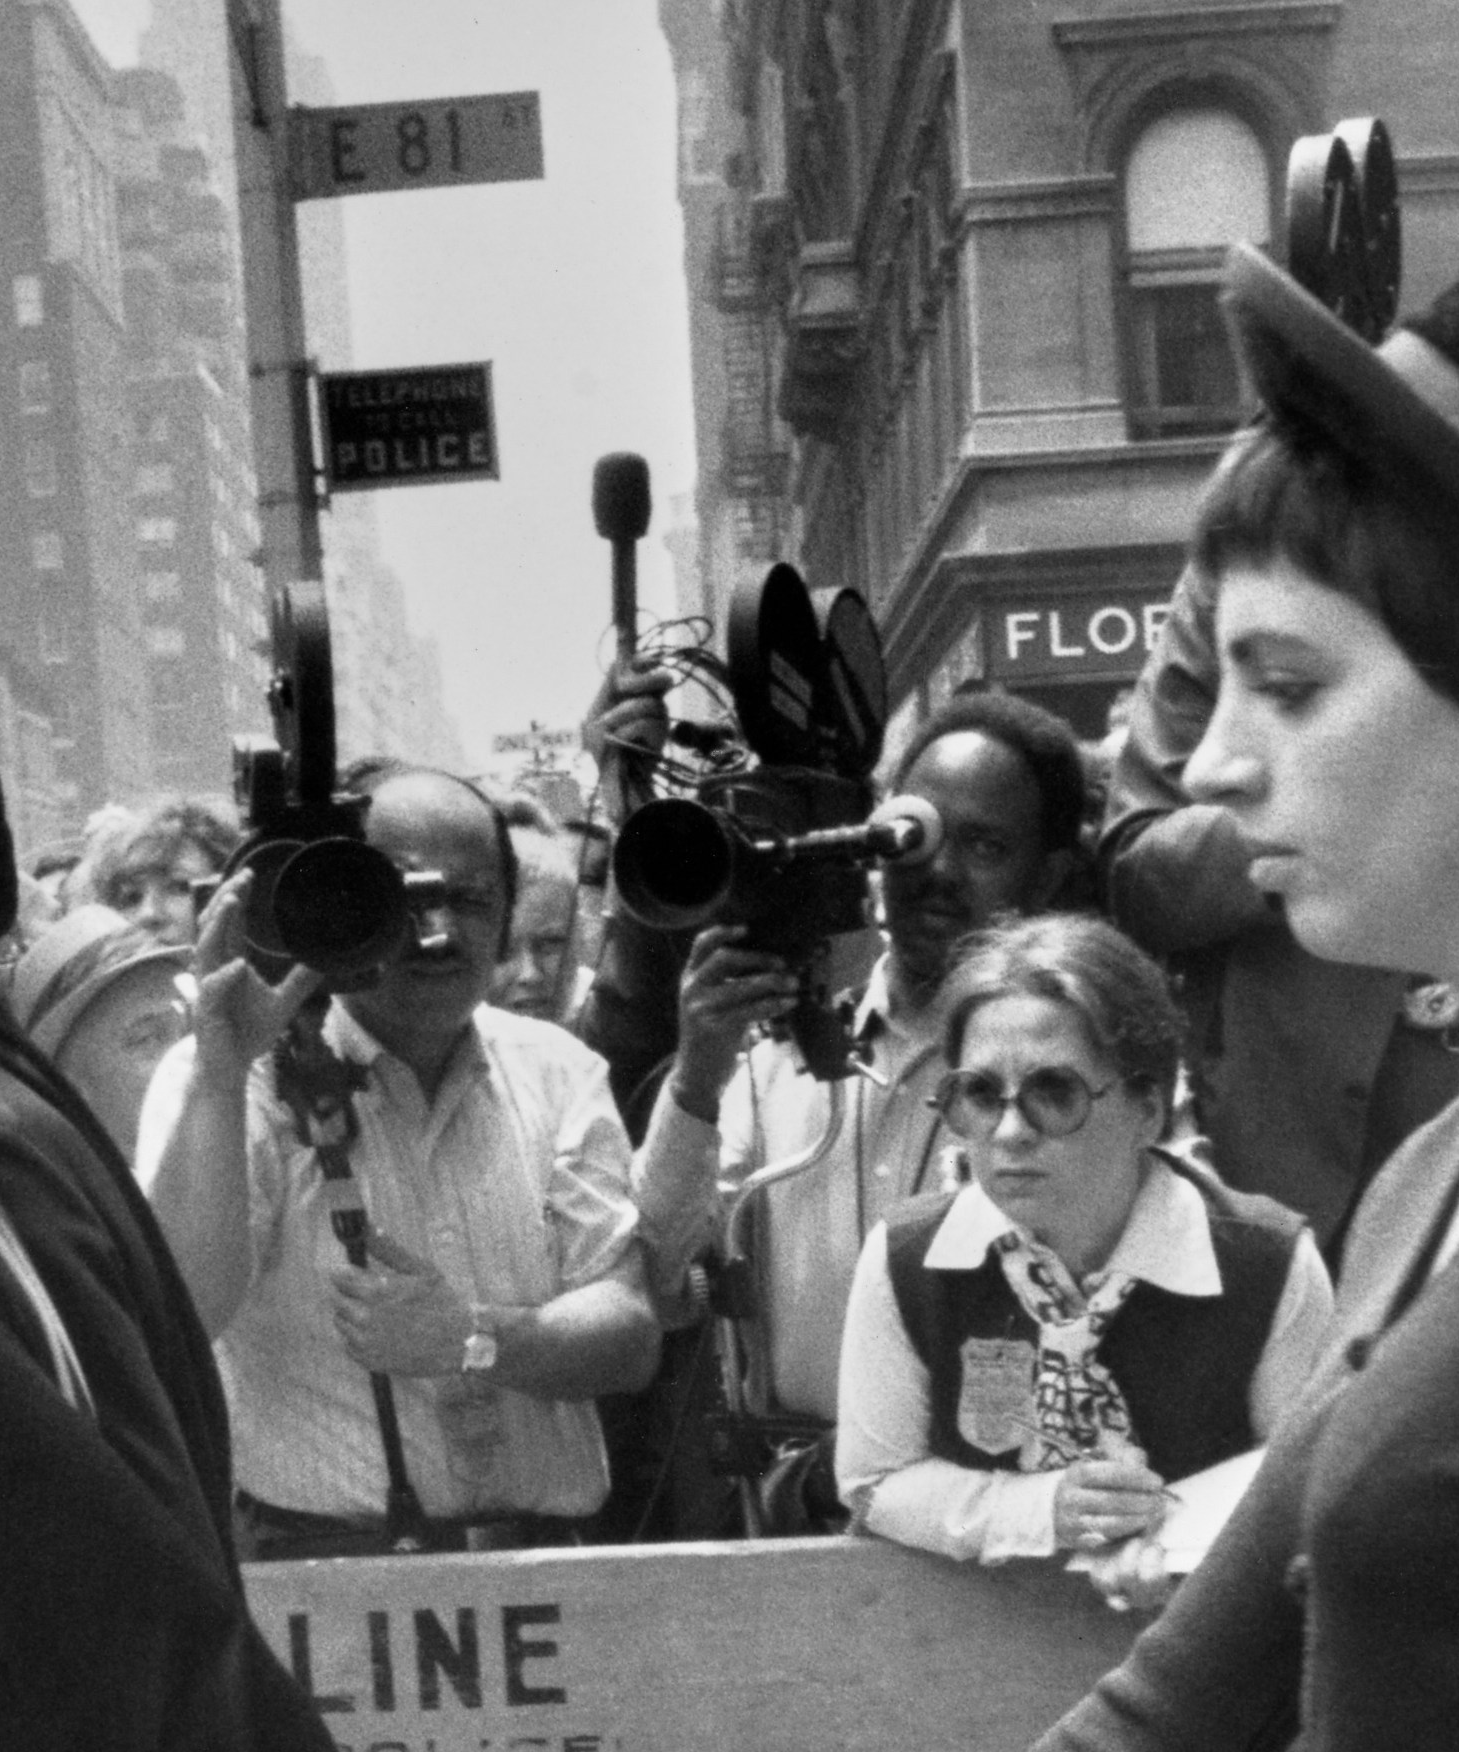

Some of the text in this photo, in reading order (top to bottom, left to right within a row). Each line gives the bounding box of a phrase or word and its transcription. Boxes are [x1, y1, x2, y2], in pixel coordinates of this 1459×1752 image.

[331, 117, 366, 184] E
[397, 108, 464, 177] 81
[336, 432, 489, 475] POLICE
[288, 1603, 567, 1714] LINE
